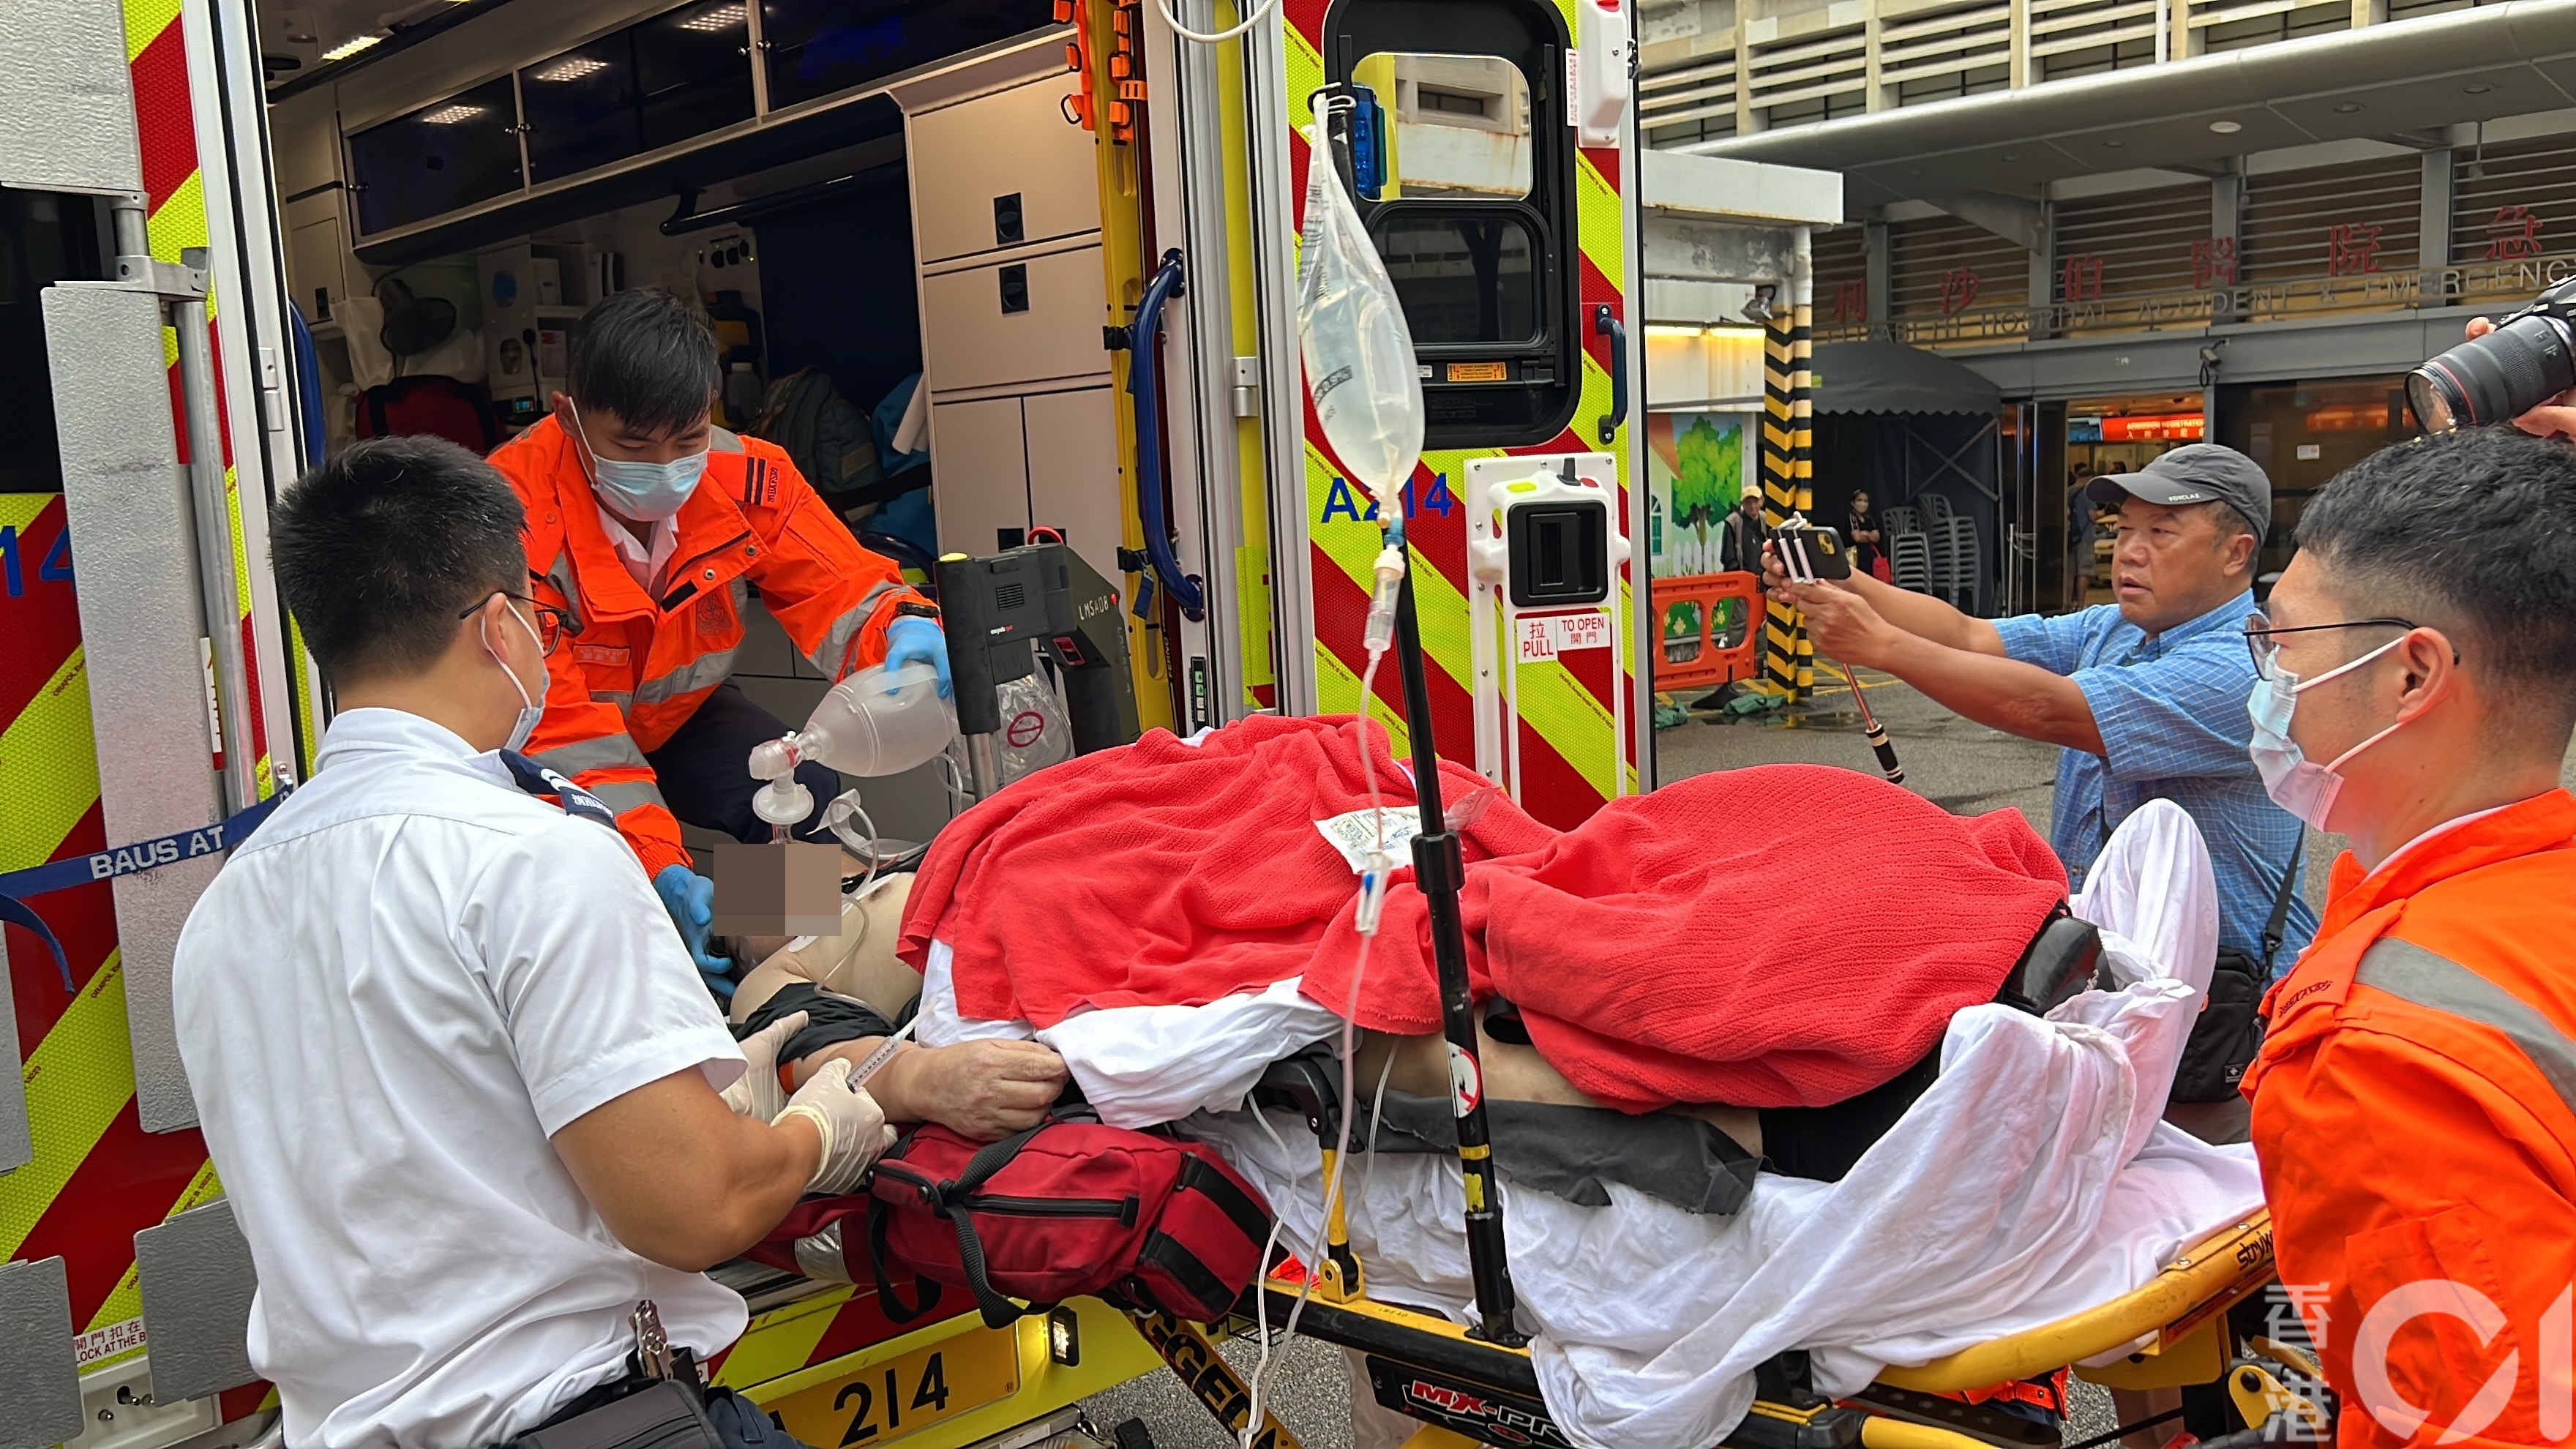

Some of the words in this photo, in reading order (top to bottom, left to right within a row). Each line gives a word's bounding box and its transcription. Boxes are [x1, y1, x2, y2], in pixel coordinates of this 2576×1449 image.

[2132, 285, 2288, 322] ACCIDENT
[2363, 258, 2576, 299] EMERGENC
[1530, 621, 1546, 639] 拉
[1562, 619, 1575, 632] TO
[1577, 617, 1604, 632] OPEN
[1524, 639, 1554, 657] PULL
[1570, 632, 1597, 644] 開門
[89, 839, 180, 880] BAUS
[190, 825, 224, 856] AT
[77, 1347, 102, 1363] OCK
[104, 1341, 116, 1355] AT
[117, 1334, 138, 1349] THE
[833, 1351, 949, 1449] 214
